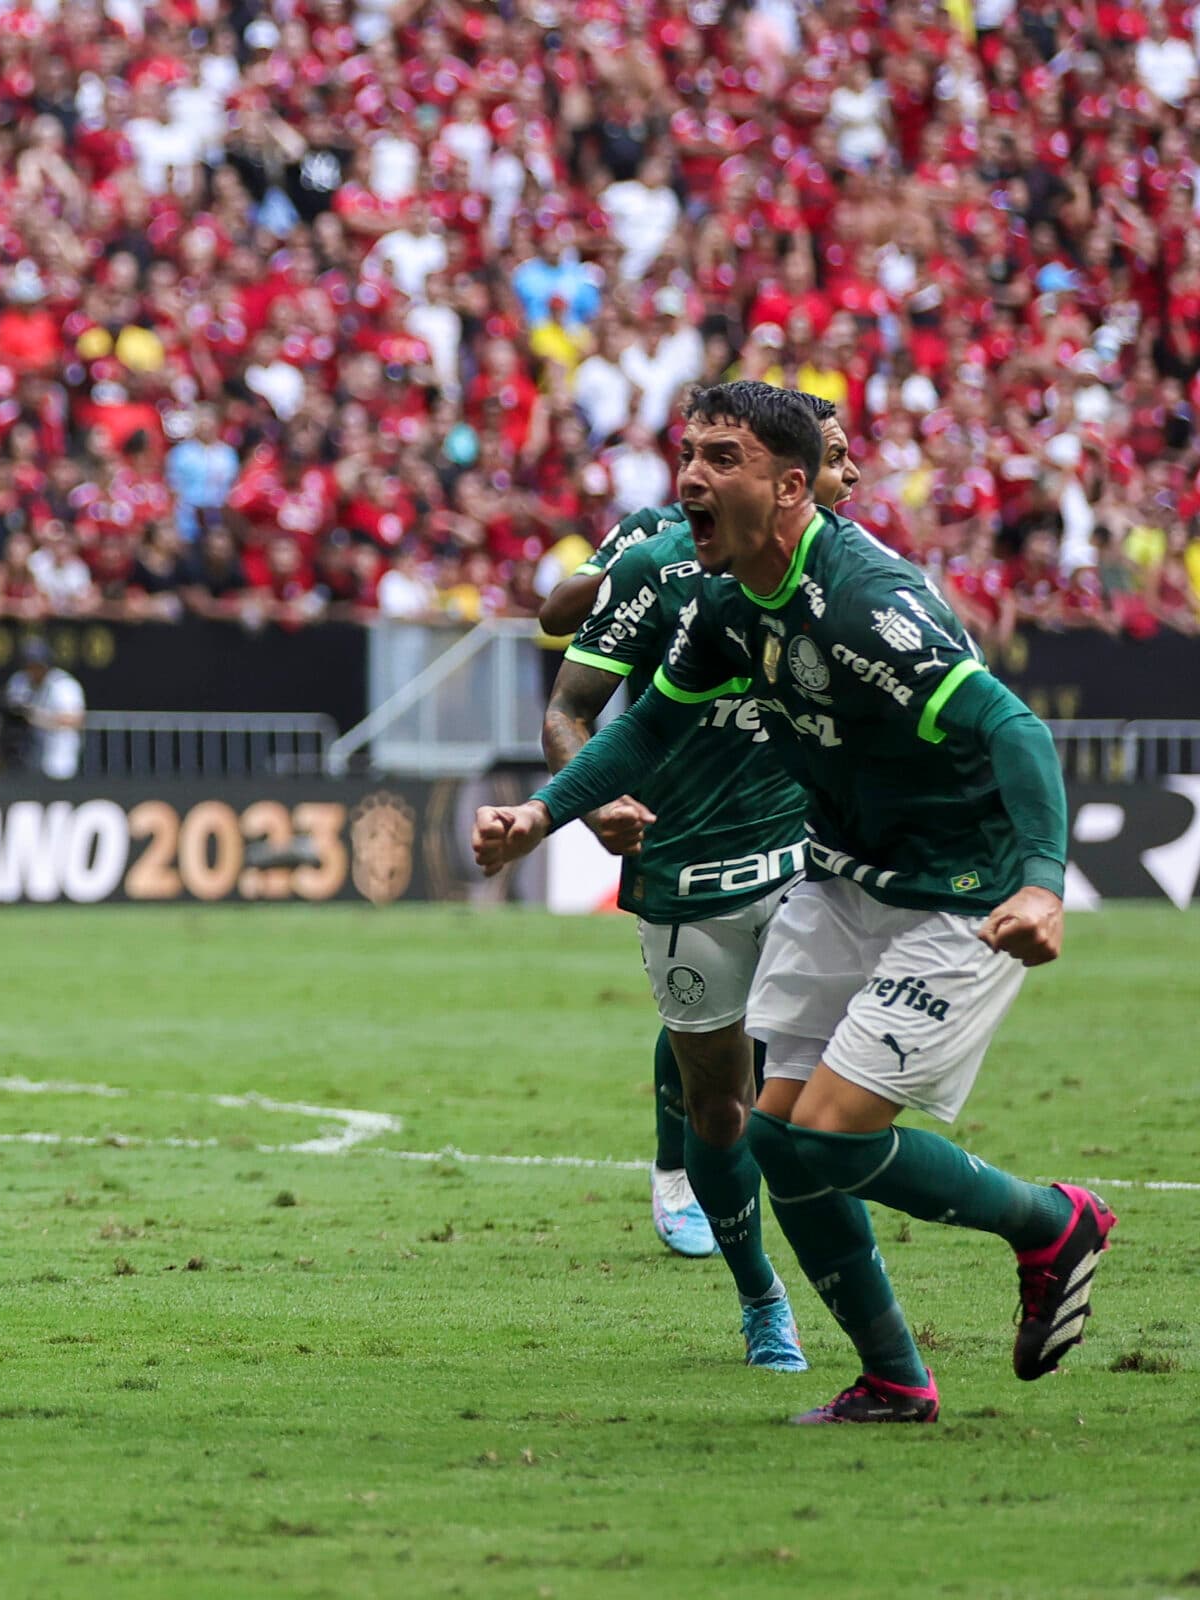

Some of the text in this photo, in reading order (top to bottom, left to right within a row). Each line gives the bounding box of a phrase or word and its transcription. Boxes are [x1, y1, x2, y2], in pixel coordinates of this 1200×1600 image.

[831, 643, 914, 707] crefisa
[124, 800, 348, 900] 2023
[866, 976, 951, 1022] refisa
